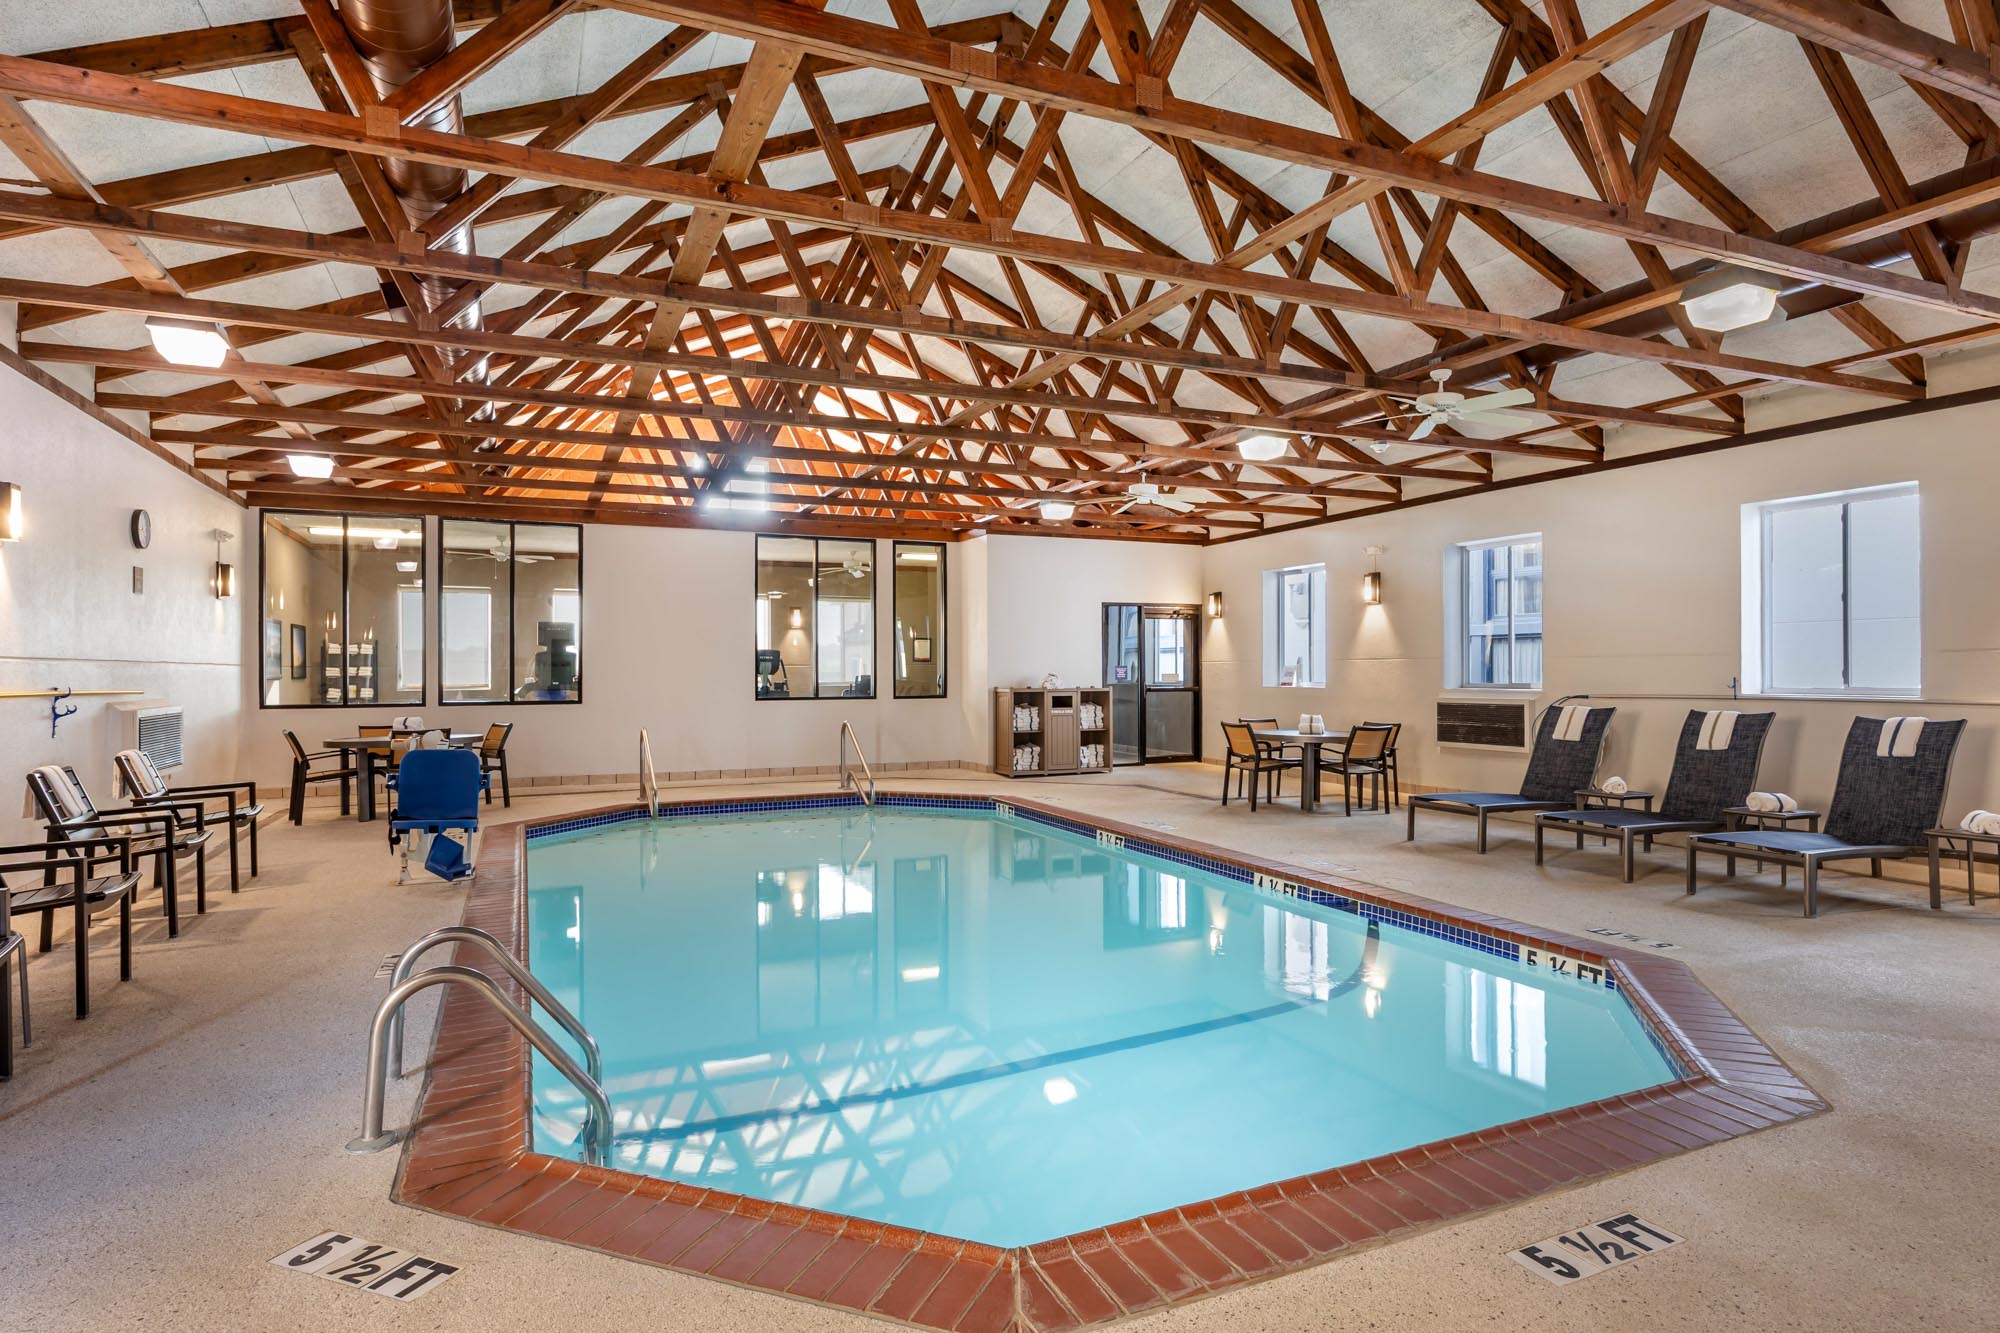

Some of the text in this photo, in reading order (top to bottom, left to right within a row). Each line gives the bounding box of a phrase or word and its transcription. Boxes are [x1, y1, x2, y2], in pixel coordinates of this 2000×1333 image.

[1283, 882, 1297, 897] FT
[1527, 949, 1538, 966] 5
[1577, 963, 1603, 985] FT
[288, 1234, 353, 1267] 5
[367, 1256, 460, 1299] FT
[1519, 1245, 1581, 1279] 5
[1596, 1213, 1675, 1252] FT
